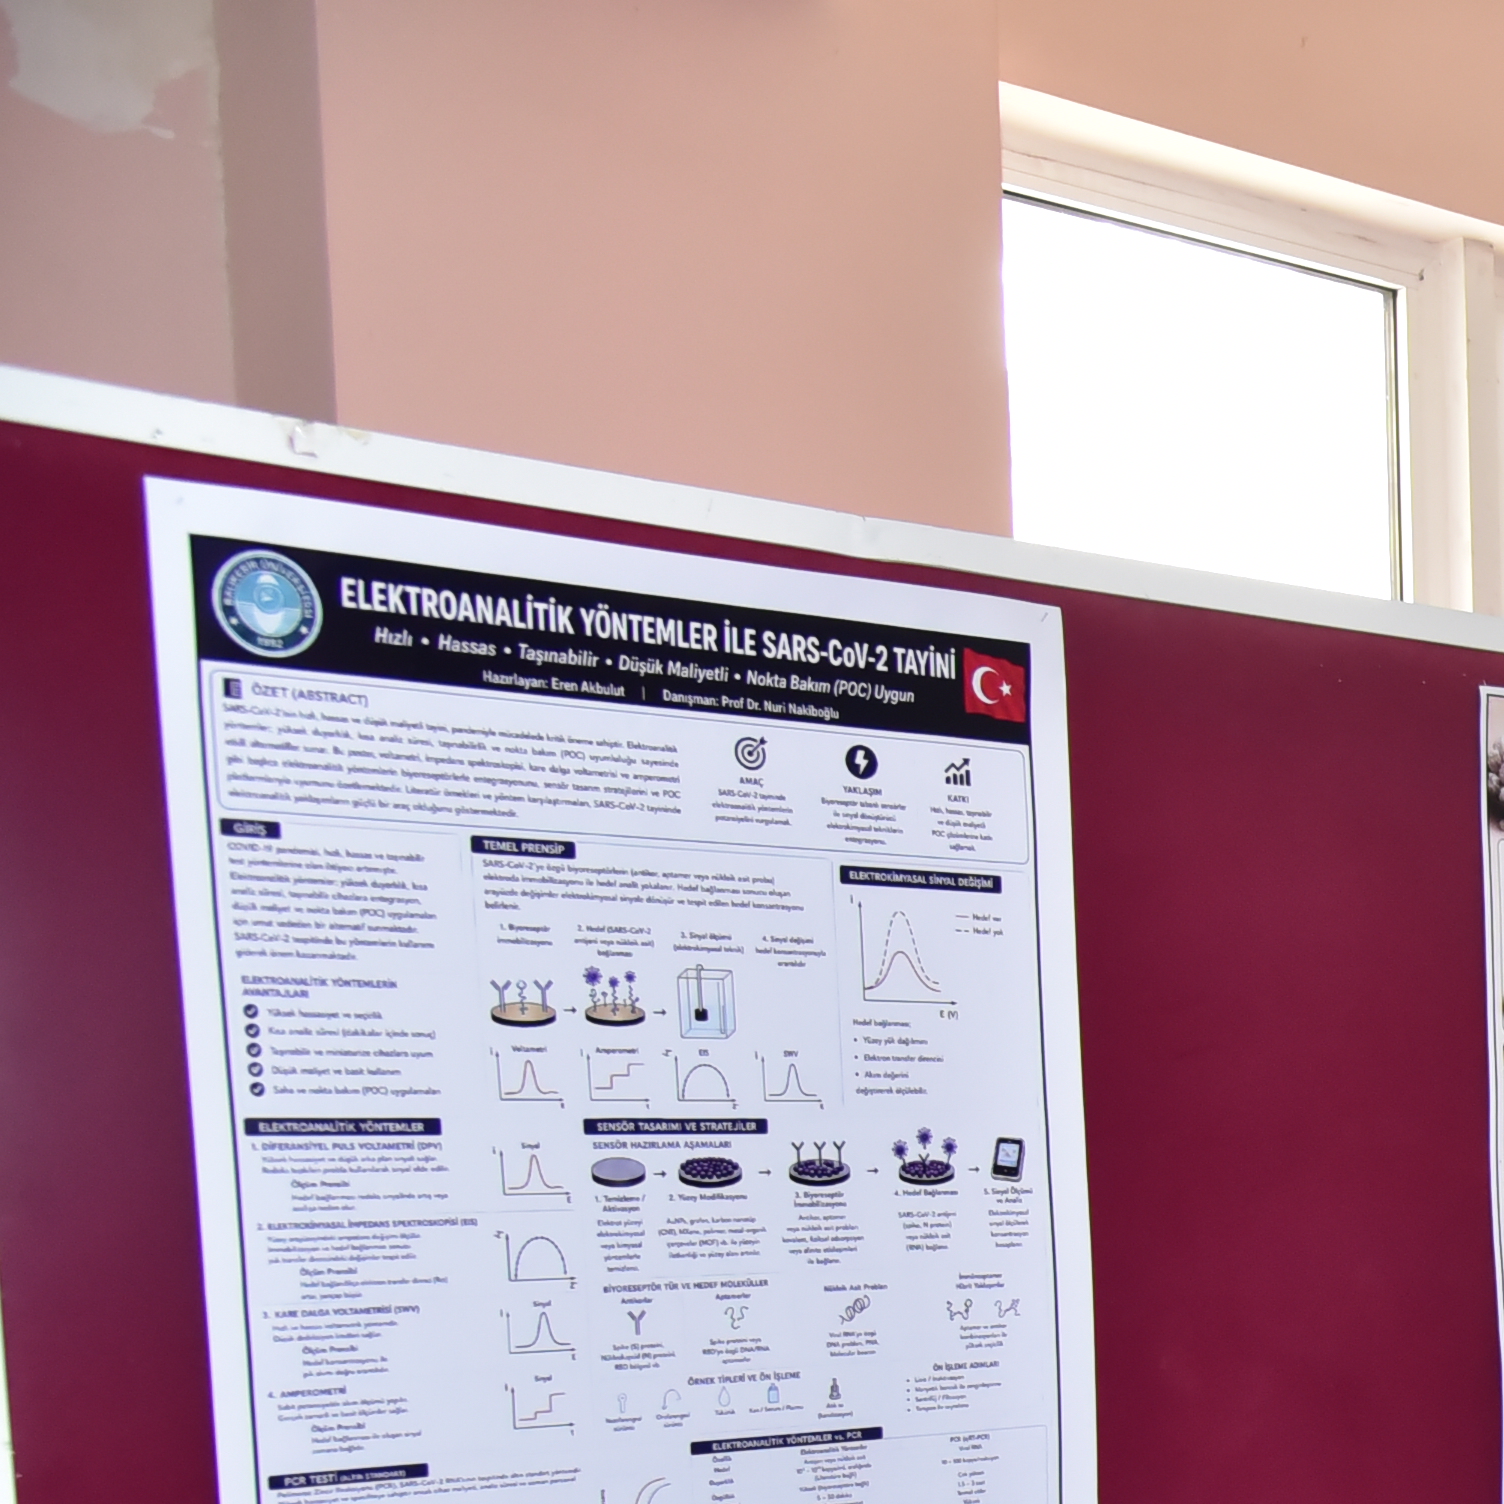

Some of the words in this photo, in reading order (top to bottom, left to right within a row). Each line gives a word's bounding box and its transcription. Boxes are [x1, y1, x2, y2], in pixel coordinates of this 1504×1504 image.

[340, 576, 575, 635] ELEKTROANALİTİK
[580, 603, 718, 652] YÖNTEMLER
[724, 619, 757, 657] İLE
[762, 631, 889, 672] SARS-CoV-2
[893, 645, 956, 680] TAYİNİ
[374, 626, 413, 647] Hızlı
[438, 633, 497, 657] Hassas
[519, 643, 600, 668] Taşınabilir
[618, 655, 663, 677] Düşük
[667, 660, 729, 683] Maliyetli
[746, 670, 787, 690] Nokta
[790, 676, 831, 694] Bakım
[833, 680, 872, 700] (POC)
[875, 686, 915, 706] Uygun
[482, 670, 548, 690] Hazırlayan:
[551, 677, 578, 692] Eren
[580, 681, 626, 697] Akbulut
[251, 682, 289, 699] ÖZET
[292, 688, 369, 708] (ABSTRACT)
[663, 689, 719, 707] Danışman:
[721, 696, 744, 710] Prof
[746, 699, 761, 711] Dr.
[763, 700, 787, 714] Nuri
[739, 776, 764, 788] AMAÇ
[843, 785, 882, 797] YAKLAŞIM
[947, 794, 969, 804] KATKI
[483, 840, 518, 852] TEMEL
[521, 842, 565, 855] PRENSİP
[849, 870, 926, 884] ELEKTROKİMYASAL
[928, 874, 956, 886] SİNYAL
[359, 1120, 425, 1132] YÖNTEMLER
[597, 1120, 635, 1132] SENSÖR
[639, 1122, 682, 1131] TASARIMI
[685, 1122, 697, 1131] VE
[700, 1121, 757, 1131] STRATEJİLER
[593, 1140, 627, 1149] SENSÖR
[630, 1141, 680, 1149] HAZIRLAMA
[681, 1282, 691, 1290] VE
[693, 1281, 718, 1289] HEDEF
[687, 1375, 715, 1386] ÖRNEK
[718, 1374, 745, 1384] TİPLERİ
[747, 1374, 757, 1382] VE
[759, 1371, 771, 1381] ÖN
[773, 1370, 800, 1381] İŞLEME
[786, 1432, 833, 1445] YÖNTEMLER
[846, 1431, 862, 1440] PCR
[284, 1476, 307, 1486] PCR
[309, 1472, 338, 1484] TESTİ
